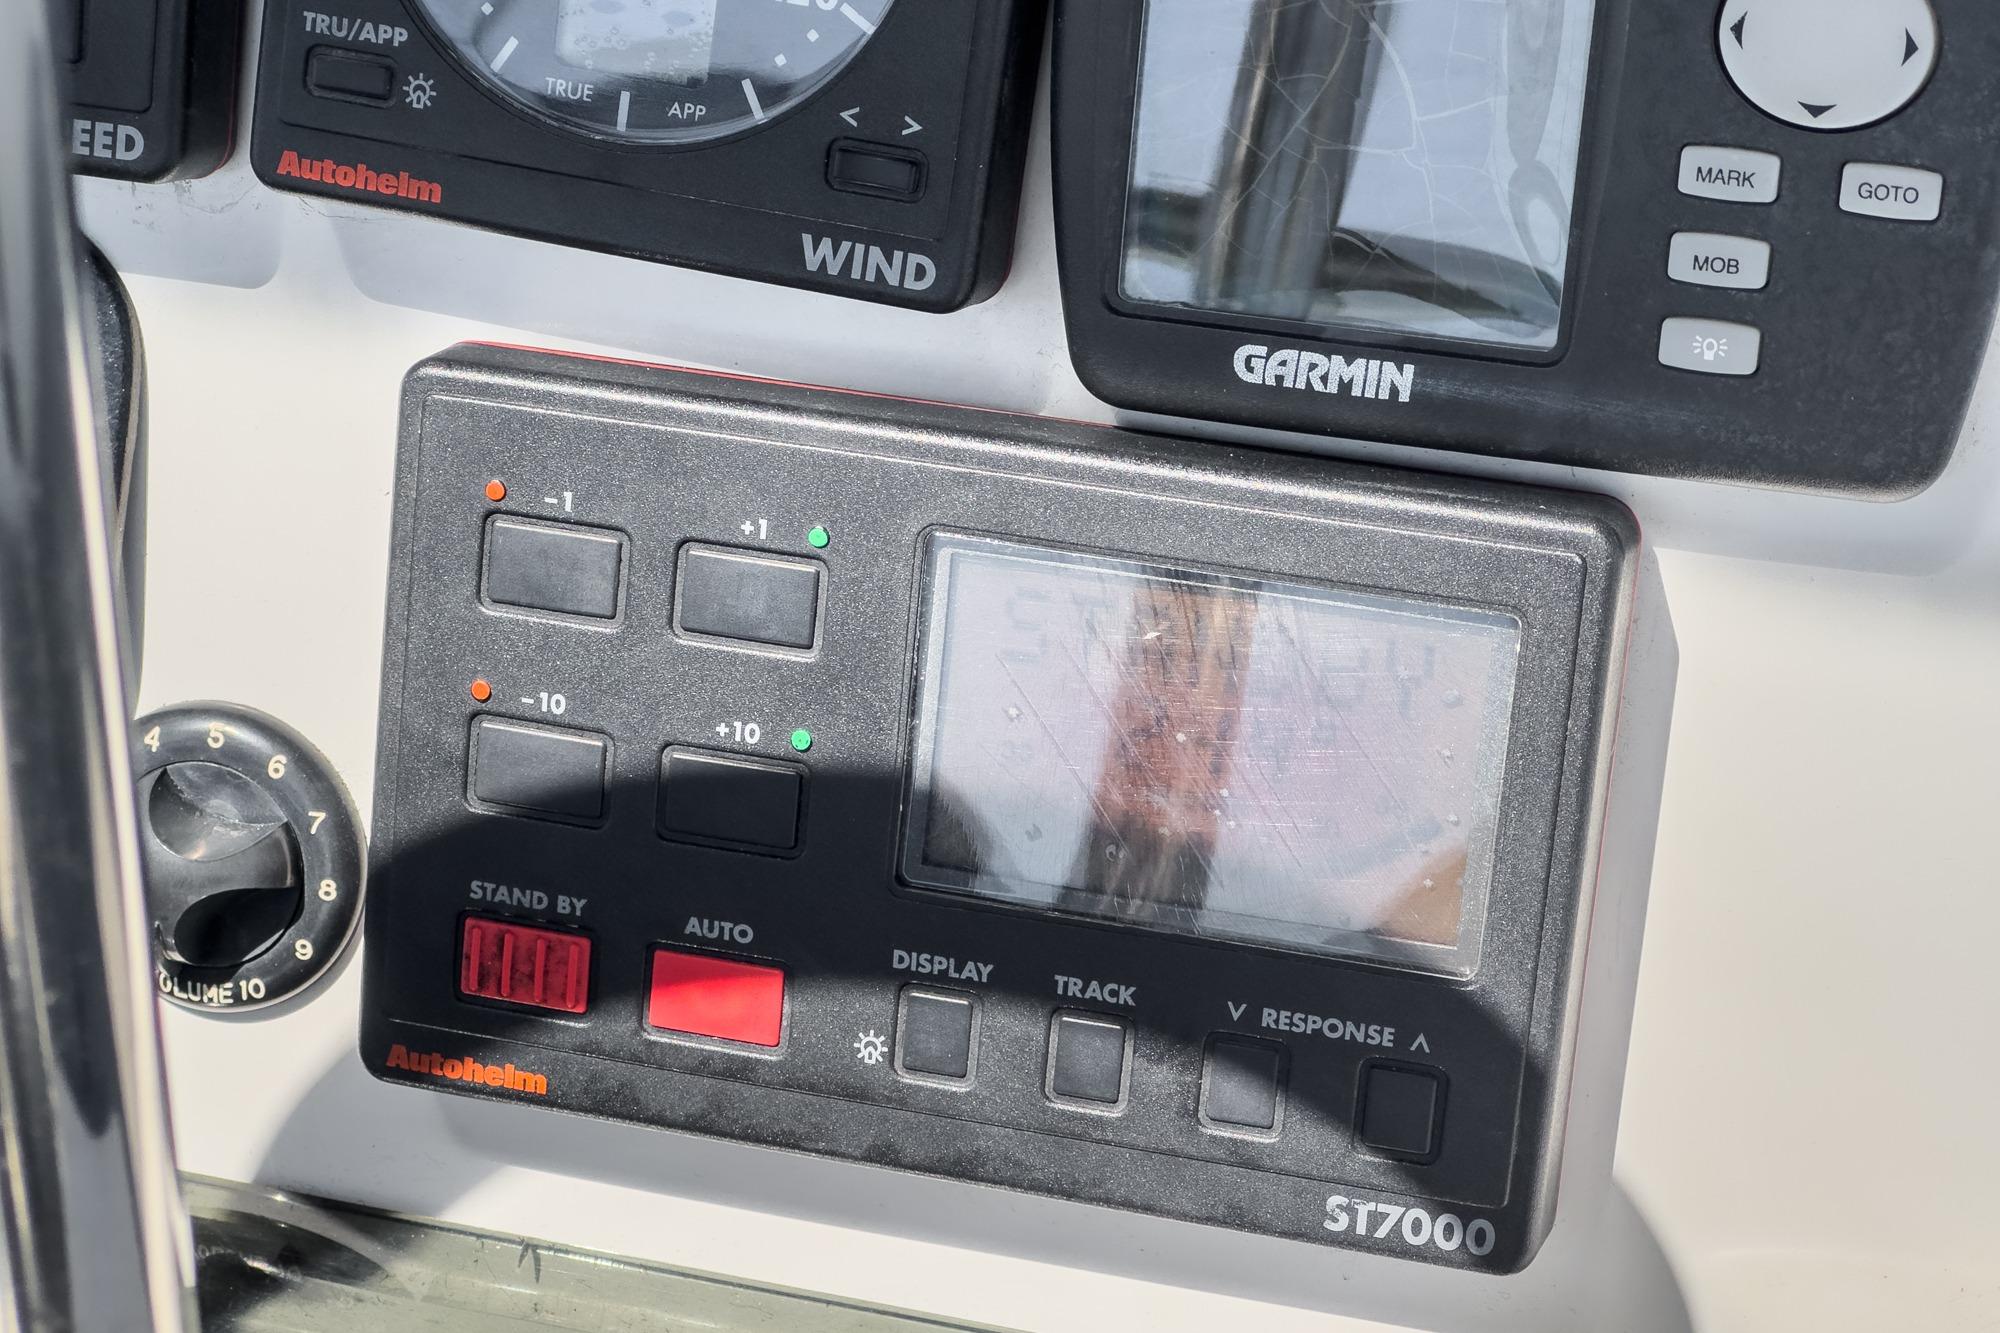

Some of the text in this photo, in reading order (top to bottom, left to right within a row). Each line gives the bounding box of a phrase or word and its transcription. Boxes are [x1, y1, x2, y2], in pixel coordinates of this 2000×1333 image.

[303, 11, 408, 47] TRU/APP
[545, 77, 594, 102] TRUE
[667, 102, 706, 121] APP
[72, 118, 145, 161] EED
[277, 150, 442, 203] Autohelm
[1695, 166, 1756, 190] MARK
[1857, 181, 1920, 206] GOTO
[801, 233, 937, 291] WIND
[1692, 253, 1741, 276] MOB
[1233, 344, 1414, 403] GARMIN
[544, 491, 573, 513] -1
[741, 518, 768, 540] +1
[521, 692, 566, 715] -10
[144, 726, 161, 752] 4
[207, 723, 226, 749] 5
[715, 720, 761, 745] +10
[267, 754, 287, 780] 6
[307, 811, 327, 835] 7
[318, 879, 338, 902] 8
[469, 879, 588, 917] STAND BY
[684, 916, 754, 944] AUTO
[294, 939, 314, 961] 9
[892, 949, 994, 983] DISPLAY
[159, 972, 266, 1004] OLUME 10
[1054, 974, 1136, 1007] TRACK
[1261, 1007, 1395, 1049] RESPONSE
[386, 1043, 548, 1096] Autohelm
[1323, 1194, 1496, 1257] ST7000
